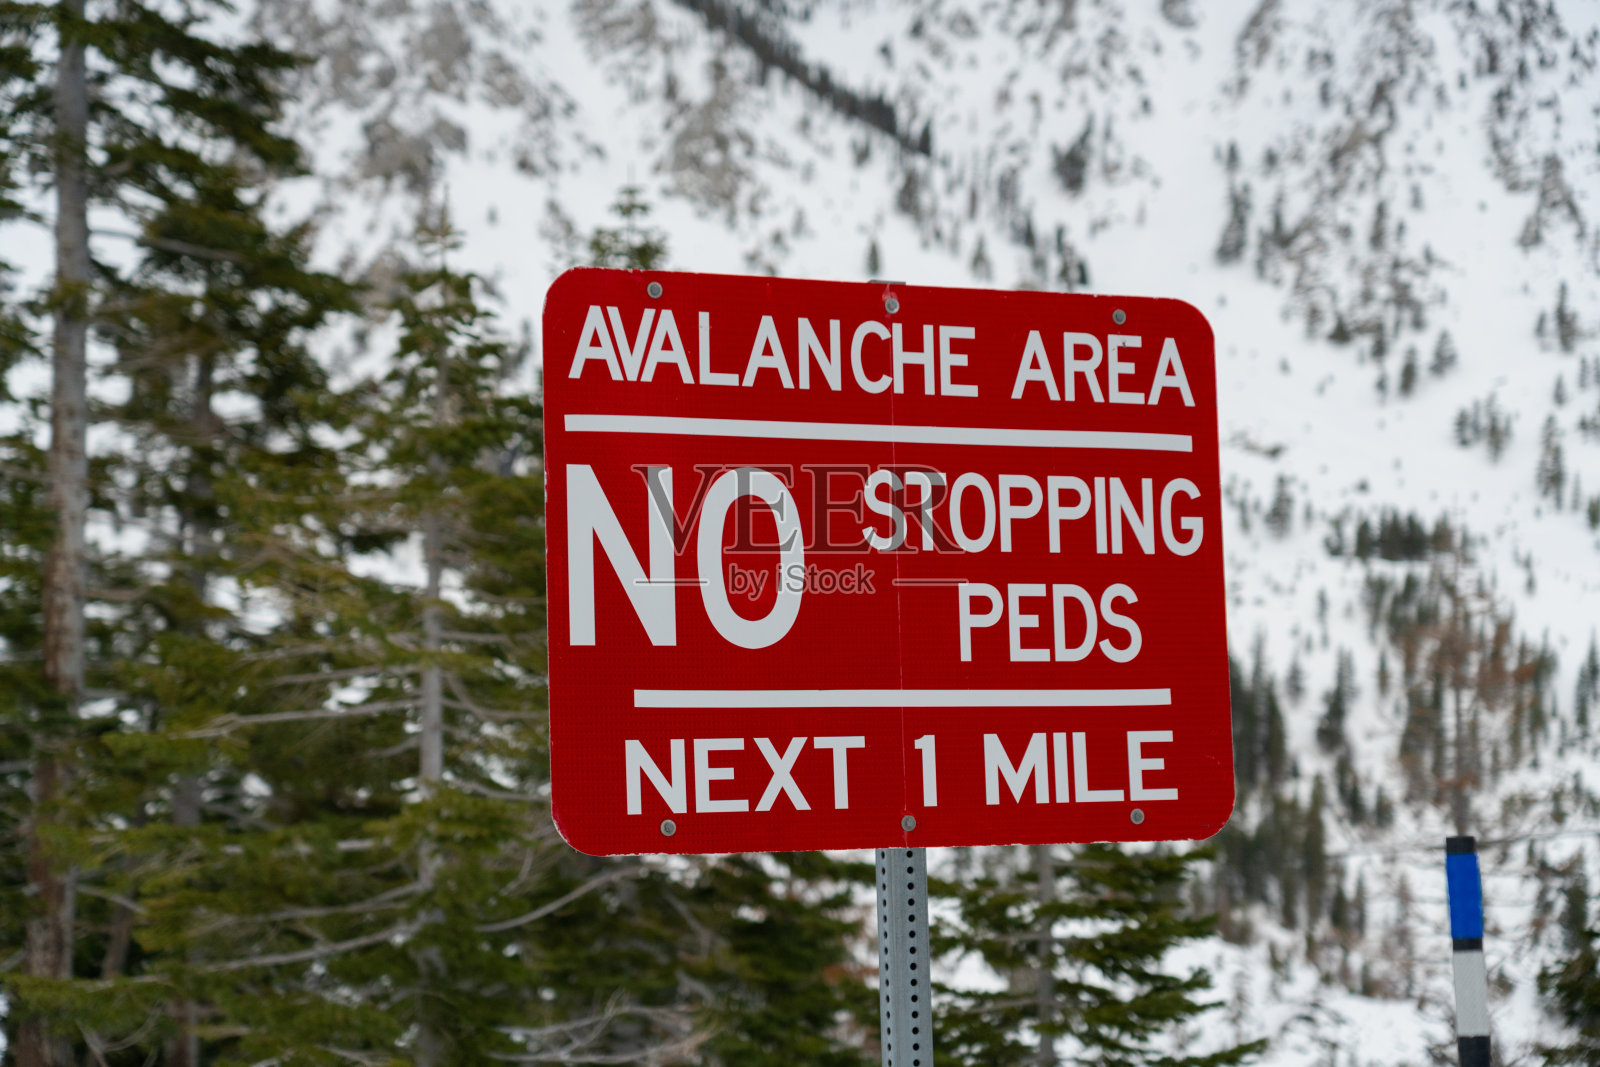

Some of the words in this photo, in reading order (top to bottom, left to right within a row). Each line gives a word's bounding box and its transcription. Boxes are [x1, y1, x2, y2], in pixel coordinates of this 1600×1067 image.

[568, 305, 979, 397] AVALANCHE
[1010, 330, 1196, 407] AREA
[566, 463, 806, 650] NO
[861, 469, 1204, 557] STOPPING
[957, 582, 1143, 663] PEDS
[624, 735, 866, 816] NEXT
[914, 734, 938, 807] 1
[983, 730, 1179, 806] MILE
